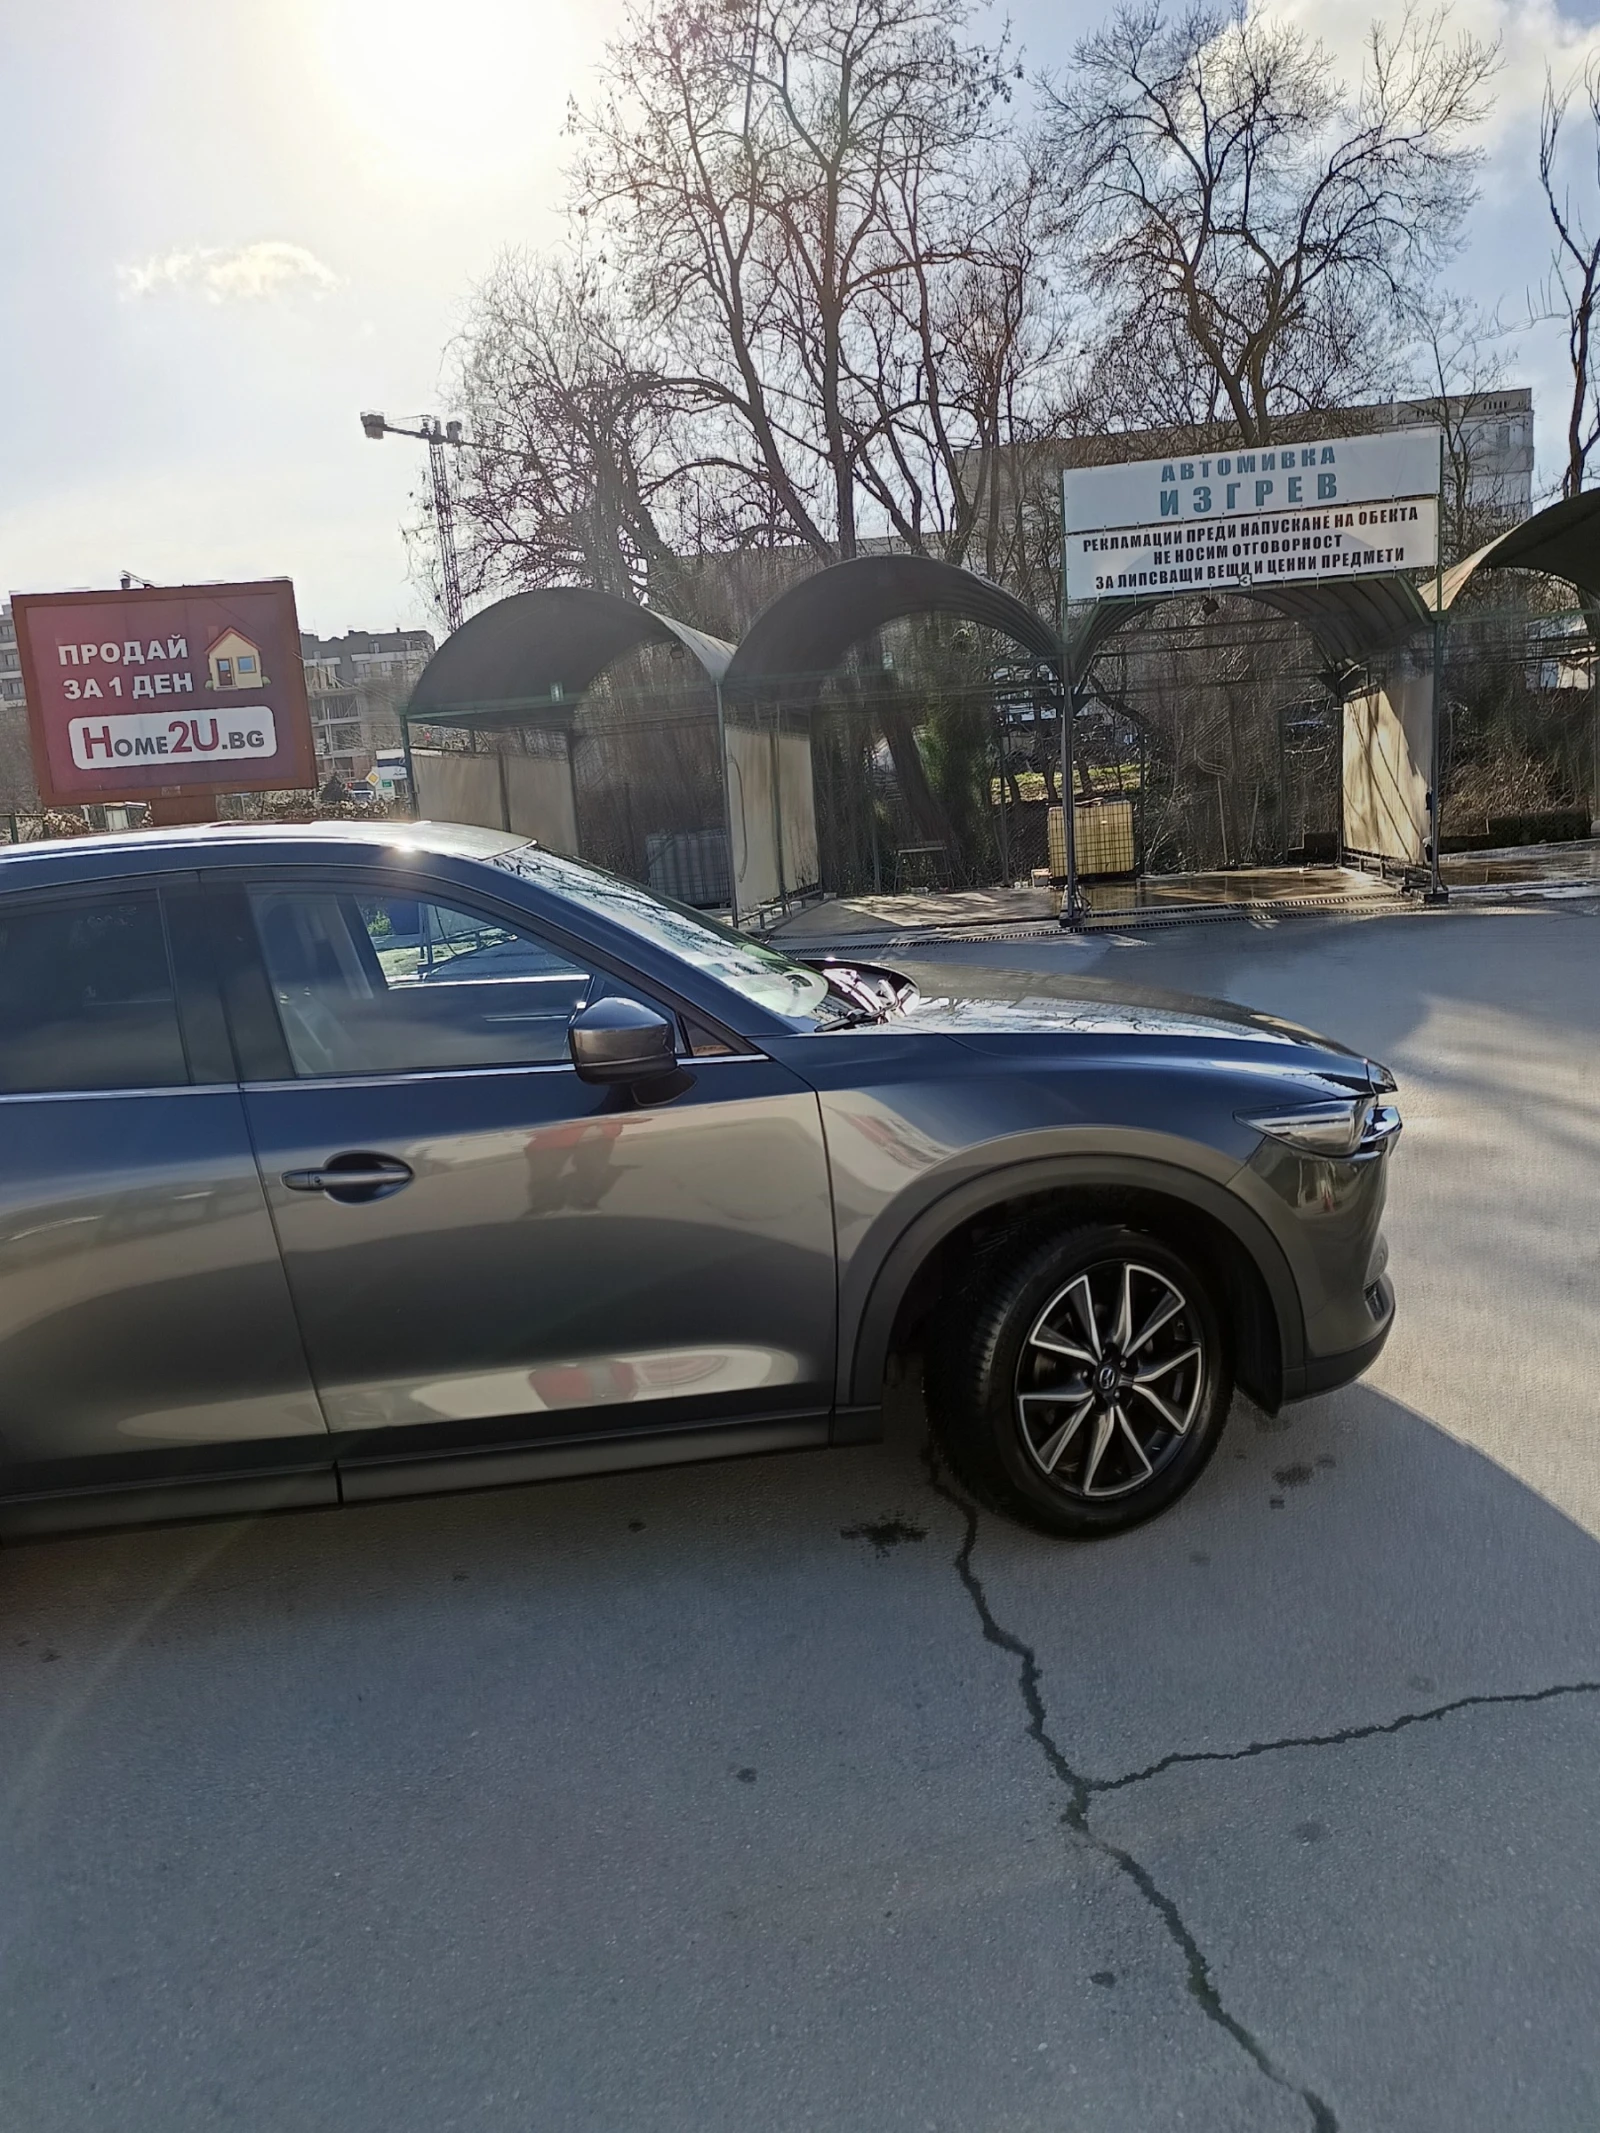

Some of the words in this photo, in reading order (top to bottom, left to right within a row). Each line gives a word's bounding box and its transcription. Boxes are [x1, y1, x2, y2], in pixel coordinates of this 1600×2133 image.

[1161, 446, 1336, 483] АВТОМИВКА
[1160, 473, 1338, 517] ИЗГРЕВ
[1083, 530, 1182, 553] РЕКЛАМАЦИИ
[1187, 524, 1236, 543] ПРЕДИ
[1241, 515, 1330, 538] НАПУСКАНЕ
[1334, 513, 1354, 529] НА
[1359, 506, 1418, 526] ОБЕКТА
[1154, 550, 1171, 565] НЕ
[1175, 545, 1228, 563] НОСИМ
[1232, 534, 1342, 557] ОТГОВОРНОСТ
[1095, 575, 1114, 590] ЗА
[1117, 567, 1203, 588] ЛИПСВАЩИ
[1207, 561, 1250, 579] ВЕЩИ
[1254, 560, 1263, 575] И
[1267, 556, 1317, 575] ЦЕННИ
[1321, 547, 1405, 568] ПРЕДМЕТИ
[58, 634, 189, 666] ПРОДАЙ
[63, 678, 104, 700] ЗА
[108, 676, 123, 697] 1
[132, 672, 194, 700] ДЕН
